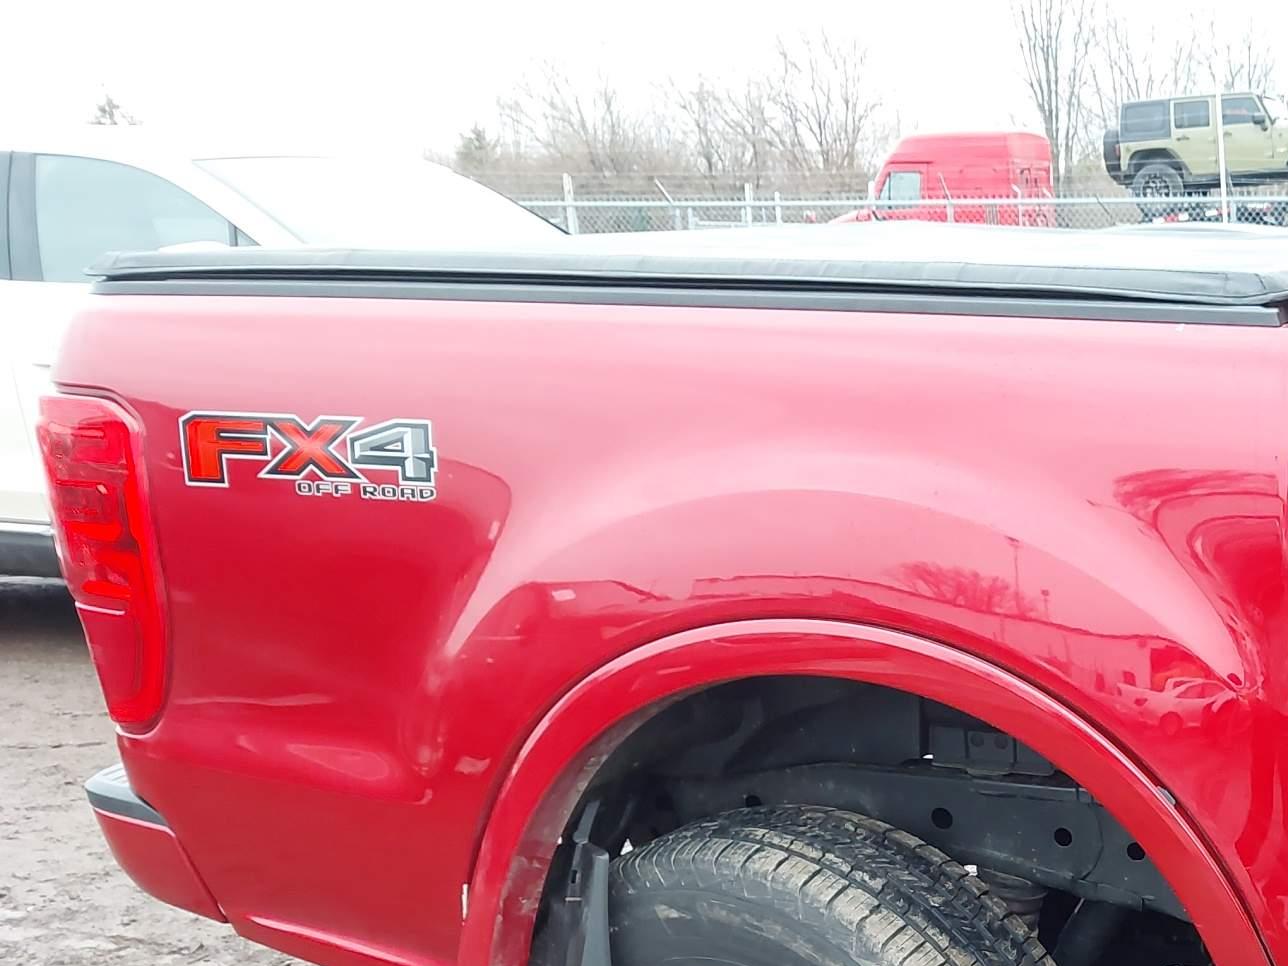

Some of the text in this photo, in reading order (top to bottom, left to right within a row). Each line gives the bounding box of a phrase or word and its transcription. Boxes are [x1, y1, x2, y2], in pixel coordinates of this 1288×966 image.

[179, 411, 437, 486] FX4
[296, 481, 436, 500] OFF ROAD
